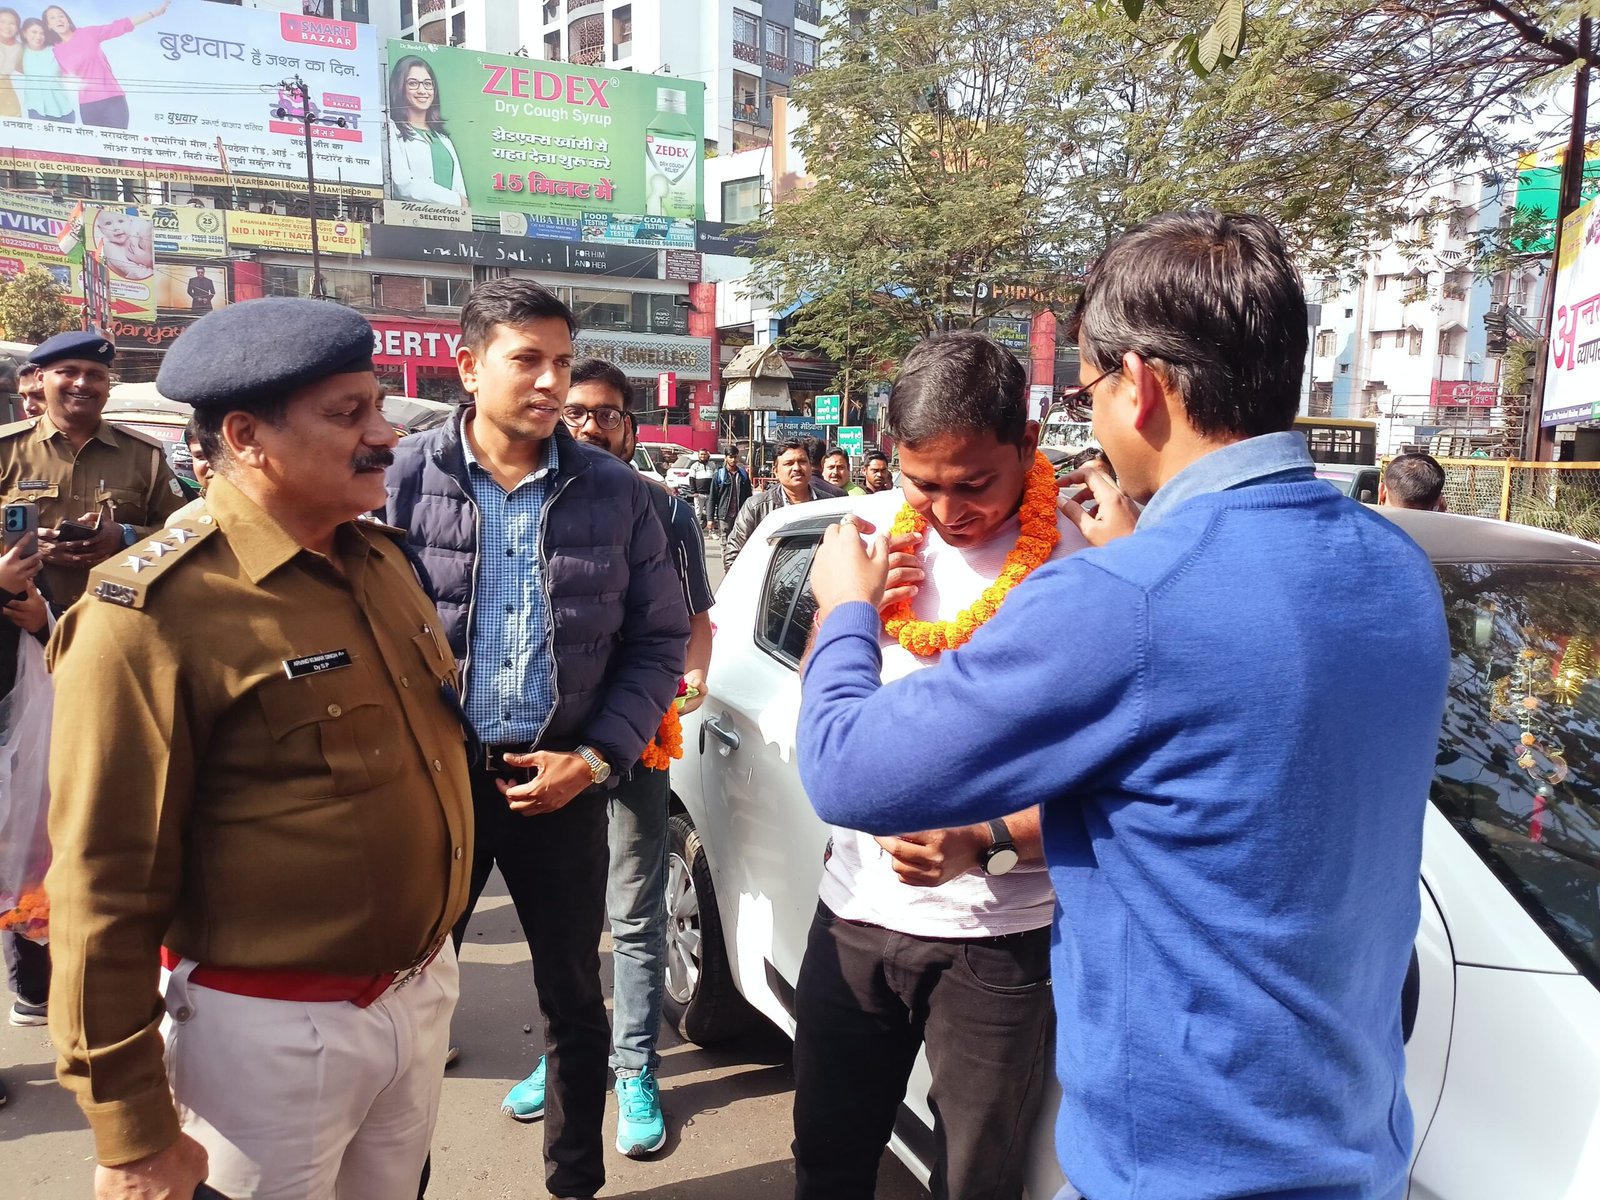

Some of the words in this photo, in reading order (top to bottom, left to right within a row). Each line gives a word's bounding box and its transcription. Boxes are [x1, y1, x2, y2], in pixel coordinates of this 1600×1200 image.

[302, 21, 350, 38] SMART
[301, 32, 352, 47] BAZAAR
[158, 31, 245, 61] बुधवार
[250, 48, 261, 66] है
[265, 54, 300, 69] जश्न
[304, 59, 325, 73] का
[481, 63, 611, 109] ZEDEX
[495, 99, 520, 118] Dry
[523, 103, 569, 122] Cough
[572, 108, 612, 127] Syrup
[57, 126, 72, 135] राम
[355, 157, 370, 166] पास
[553, 135, 594, 151] खांसी
[595, 137, 609, 153] से
[655, 144, 689, 158] ZEDEX
[183, 149, 203, 160] सिटी
[491, 147, 528, 162] राहत
[528, 147, 557, 164] देना
[39, 162, 55, 171] GEL
[56, 164, 94, 174] CHURCH
[95, 167, 135, 177] COMPLEX
[184, 173, 225, 183] RAMGARH
[491, 171, 524, 192] 15
[527, 169, 591, 199] मिनट
[592, 177, 614, 202] में
[401, 202, 467, 216] Mahendra's
[583, 212, 608, 220] FOOD
[419, 213, 460, 223] SELECTION
[529, 213, 554, 225] MBA
[556, 216, 578, 227] HUB
[584, 219, 608, 227] TESTING
[231, 226, 250, 235] NID
[258, 229, 281, 237] NIFT
[609, 223, 635, 231] WATER
[610, 230, 636, 238] TESTING
[575, 249, 590, 257] FOR
[591, 251, 605, 259] HIM
[574, 260, 590, 268] AND
[591, 261, 607, 269] HER
